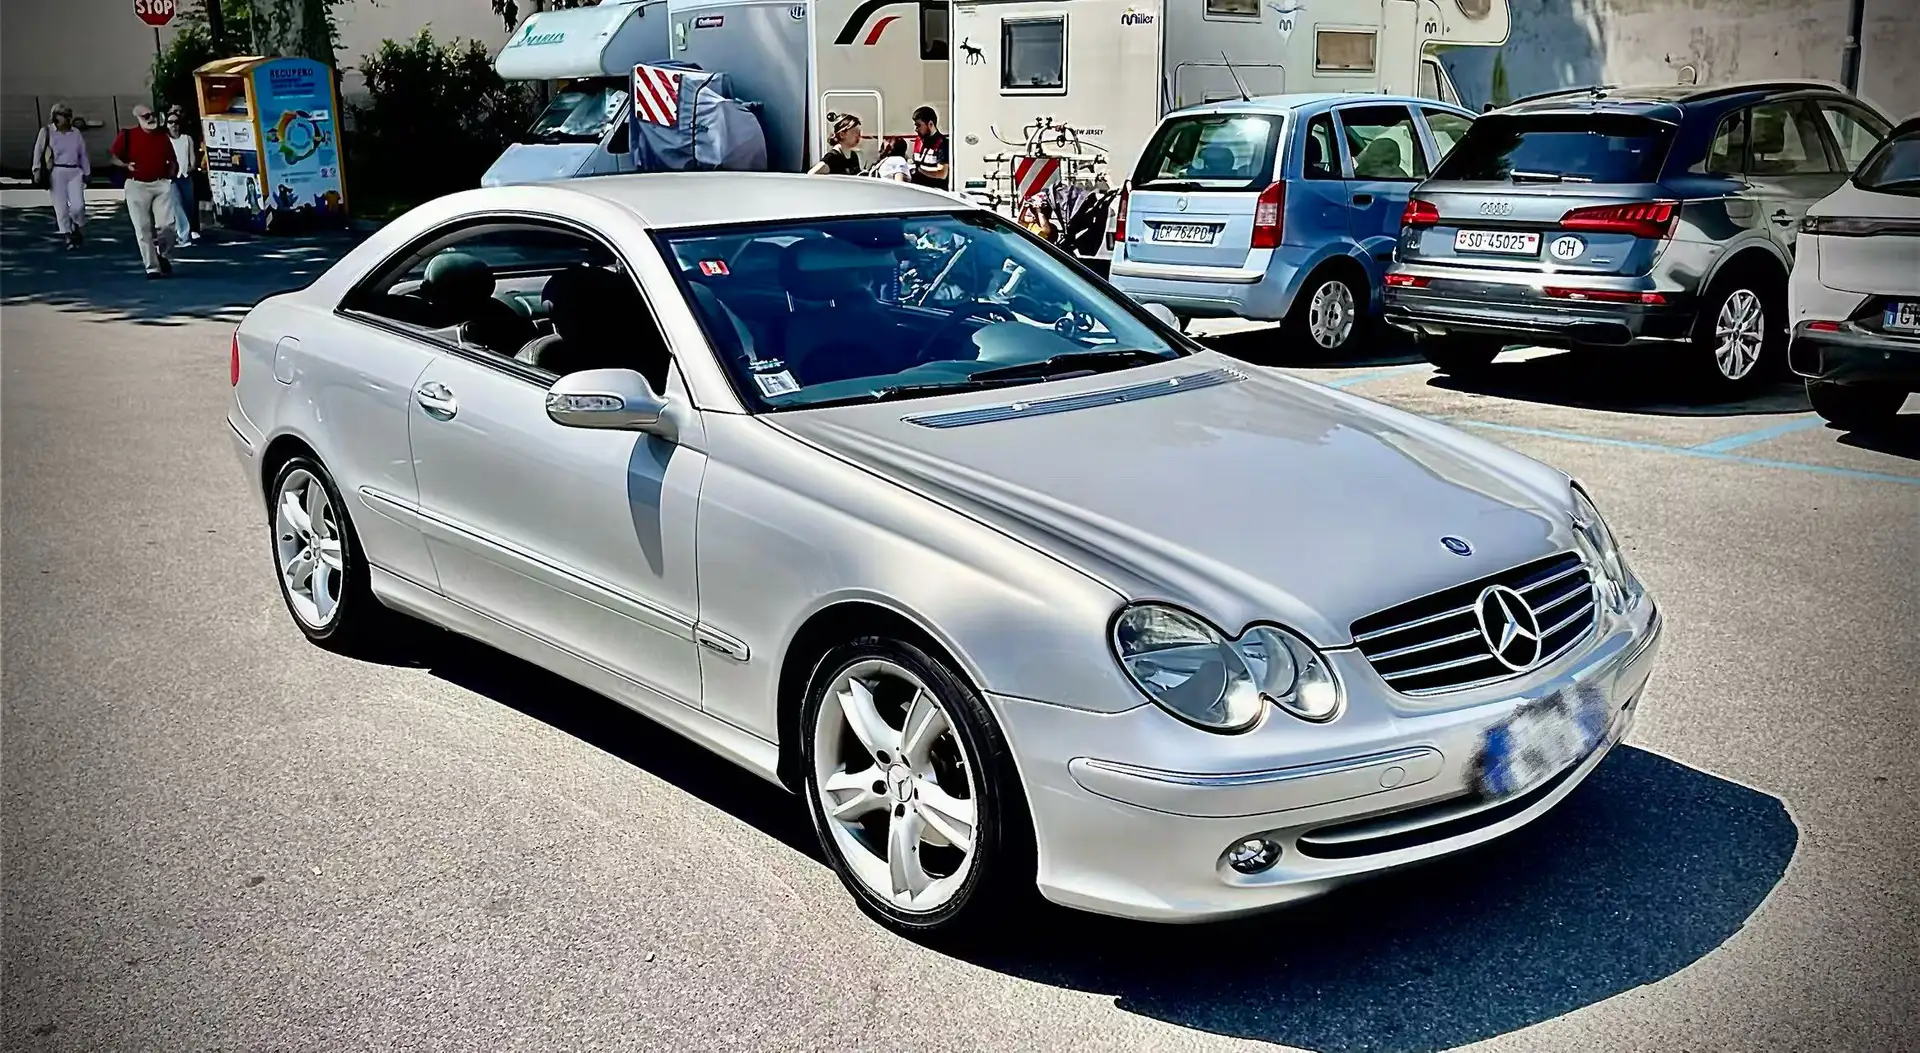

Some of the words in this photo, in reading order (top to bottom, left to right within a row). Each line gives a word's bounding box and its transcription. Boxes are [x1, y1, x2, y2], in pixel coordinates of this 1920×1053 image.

[136, 0, 172, 14] STOP
[1121, 13, 1154, 25] Miller
[1160, 225, 1172, 239] CR
[1558, 240, 1576, 256] CH
